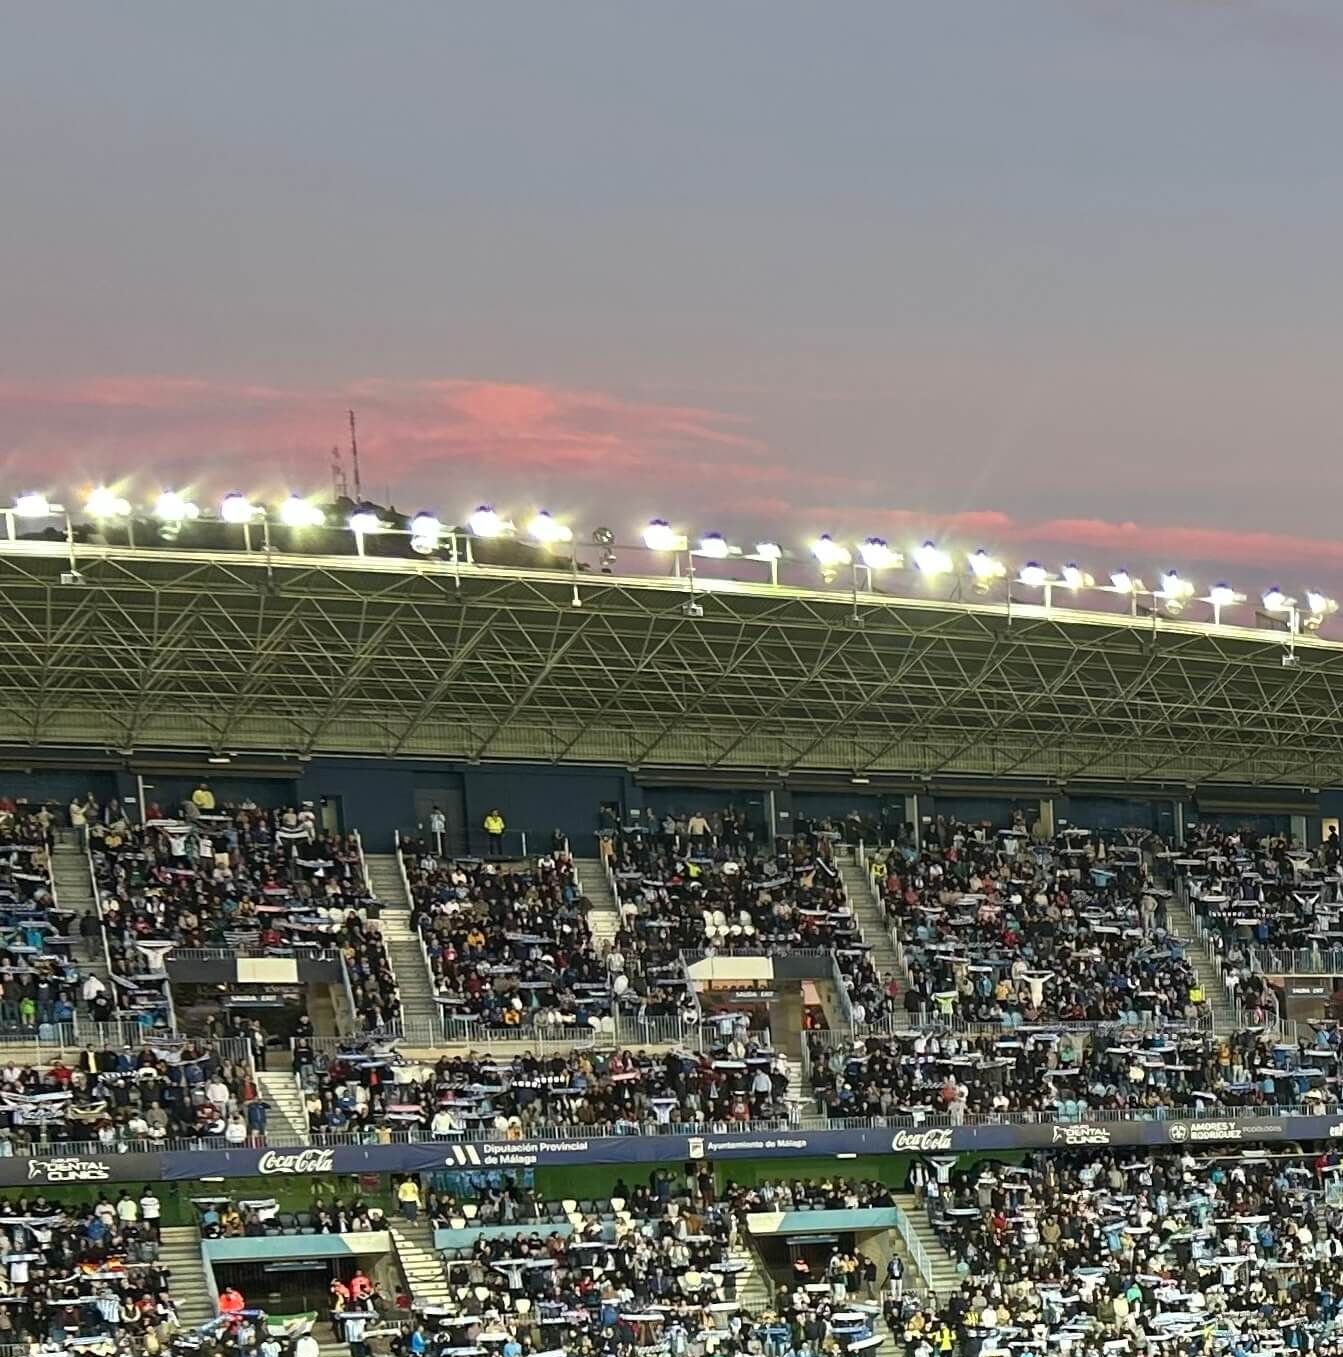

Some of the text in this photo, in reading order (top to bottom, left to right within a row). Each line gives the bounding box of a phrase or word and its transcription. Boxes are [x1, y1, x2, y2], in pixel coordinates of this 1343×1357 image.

[1191, 1122, 1227, 1131] AMORES
[1066, 1128, 1110, 1137] DENTAL
[483, 1141, 588, 1154] Diputación Provincial
[484, 1154, 536, 1165] de Málaga
[47, 1161, 110, 1173] DENTAL
[47, 1171, 110, 1181] CLINICS
